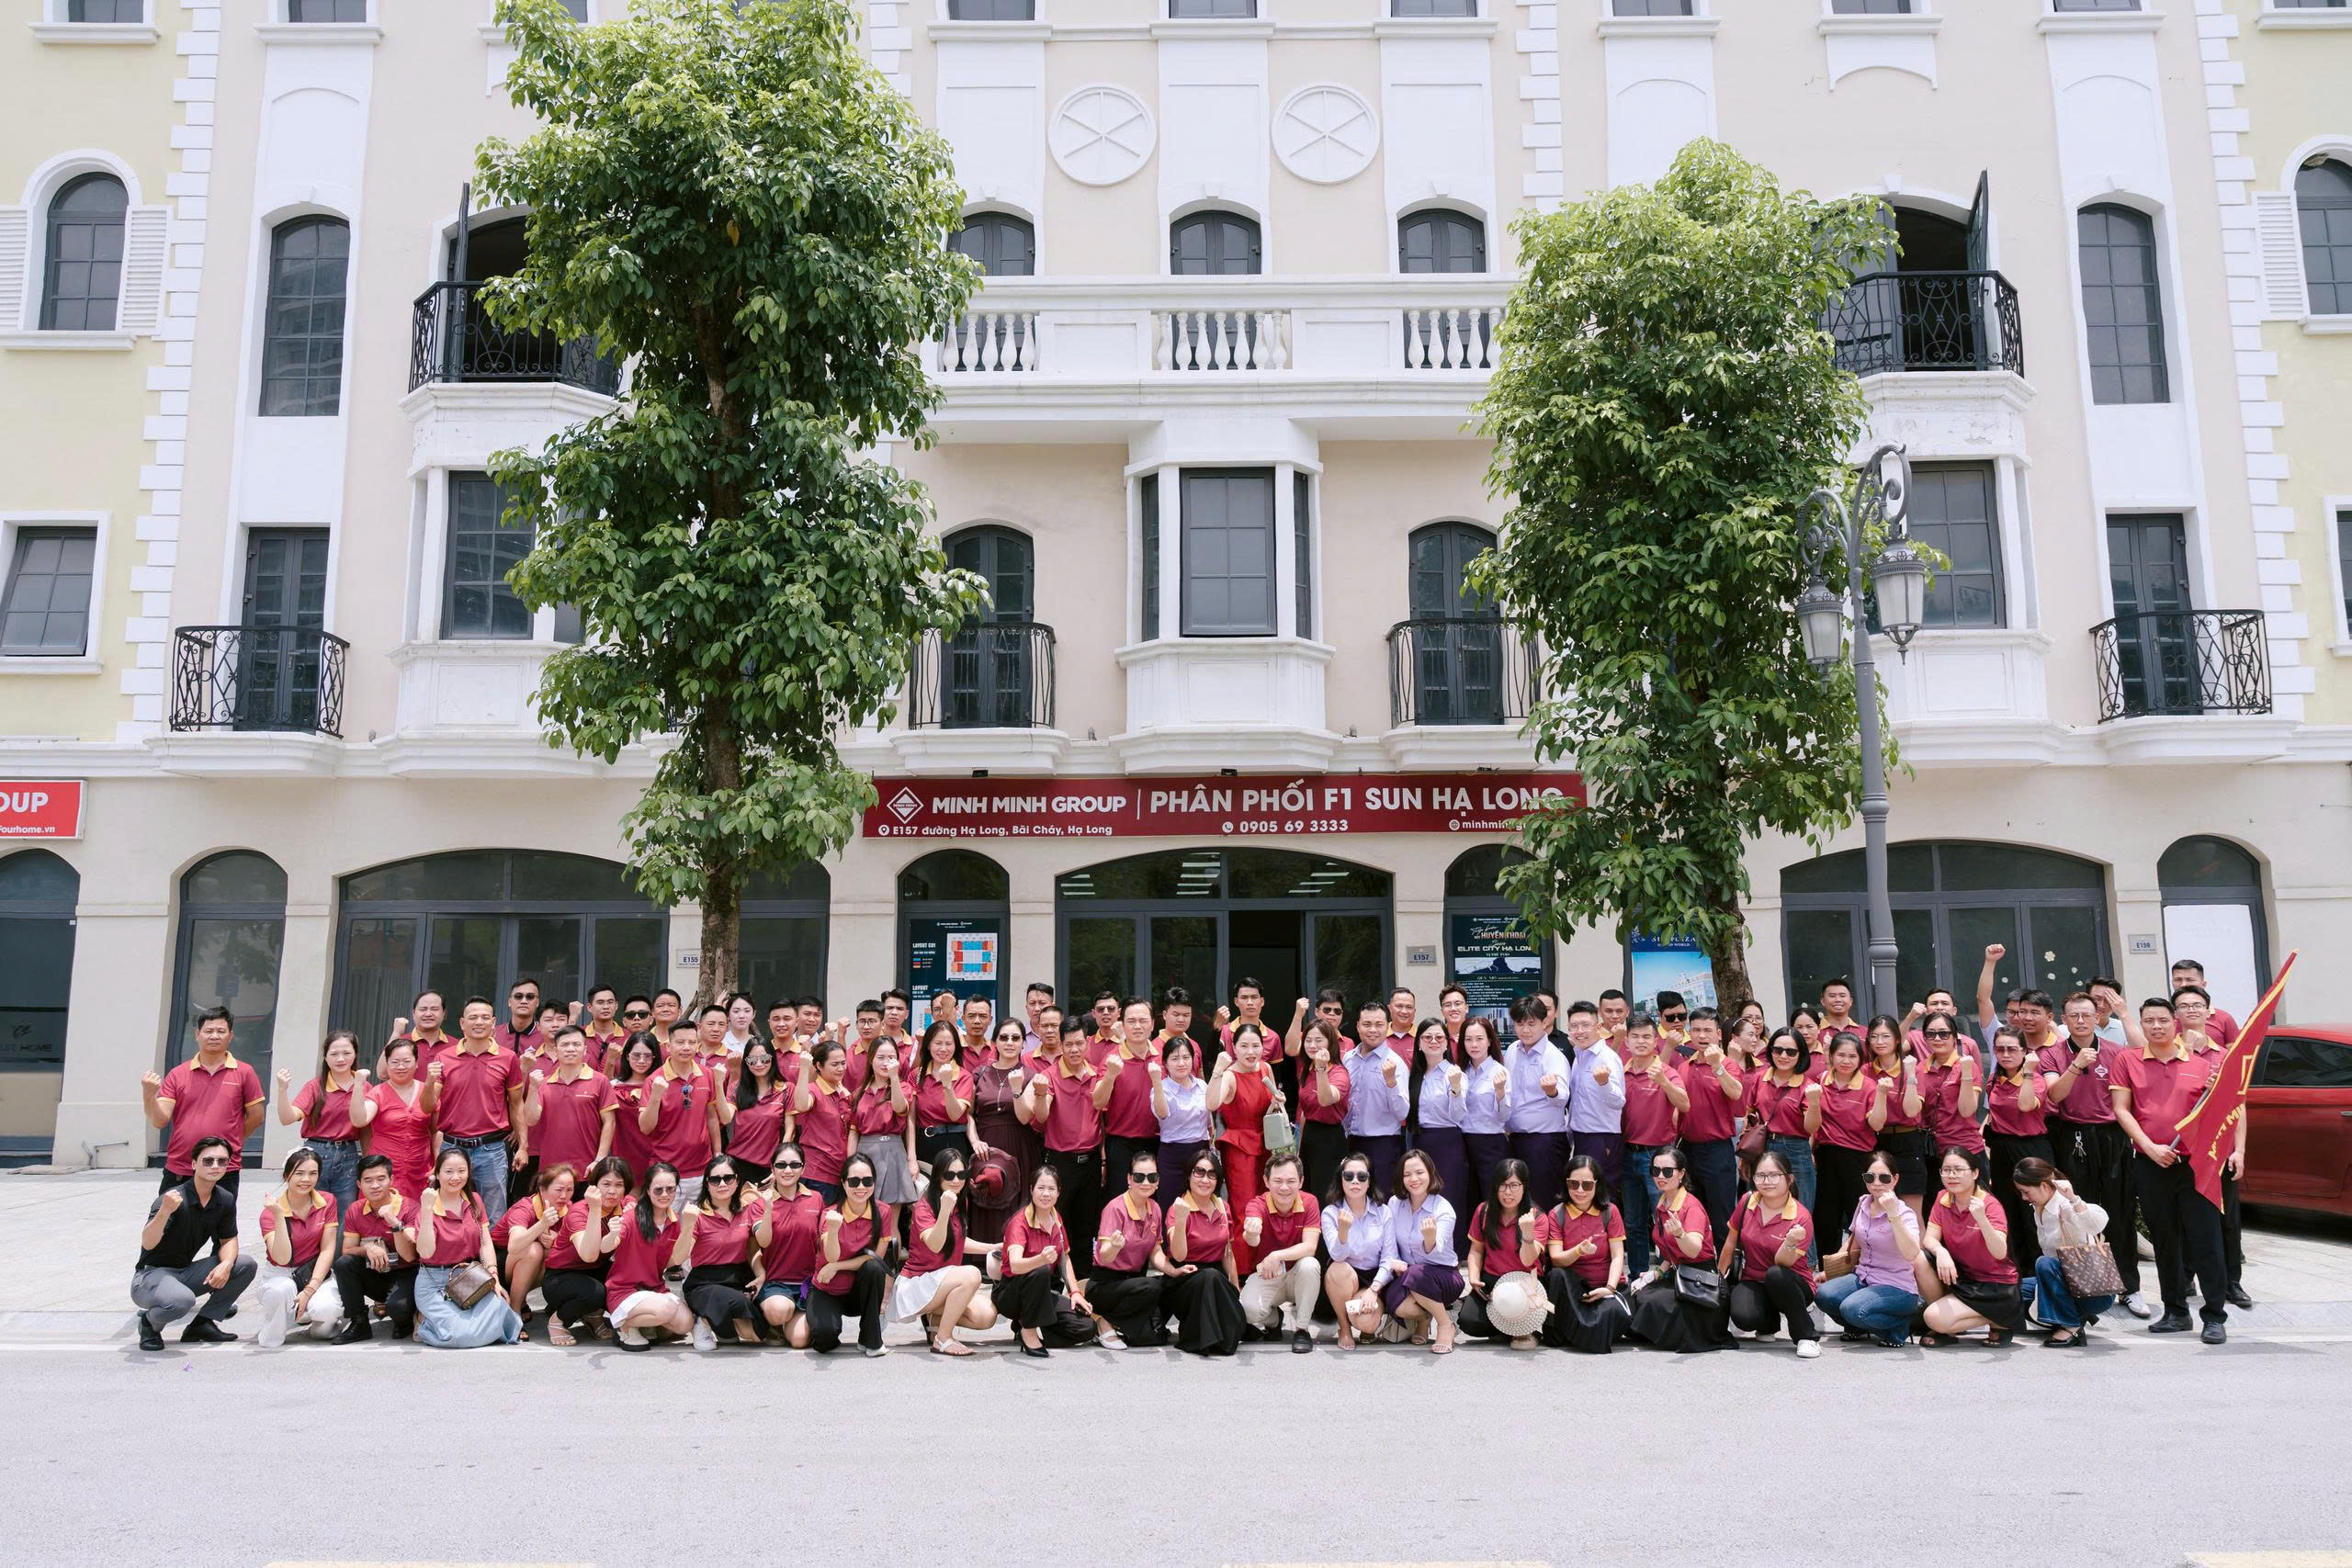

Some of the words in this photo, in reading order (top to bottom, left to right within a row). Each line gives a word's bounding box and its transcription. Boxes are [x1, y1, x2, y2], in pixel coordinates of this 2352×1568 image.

[932, 796, 988, 814] MINH
[992, 795, 1046, 813] MINH
[1051, 795, 1127, 813] GROUP
[1150, 784, 1232, 813] PHÂN
[1242, 778, 1314, 812] PHỐI
[1324, 787, 1351, 811] F1
[1365, 787, 1422, 810] SUN
[1432, 787, 1474, 817] HẠ
[893, 826, 918, 835] E157
[922, 824, 957, 837] đường
[961, 826, 977, 837] Hạ
[979, 826, 1009, 837] Long,
[1012, 825, 1030, 835] Bãi
[1033, 825, 1064, 836] Cháy,
[1068, 825, 1083, 836] Hạ
[1086, 825, 1113, 836] Long
[1240, 820, 1278, 833] 0905
[1284, 820, 1305, 832] 69
[1310, 819, 1349, 831] 3333
